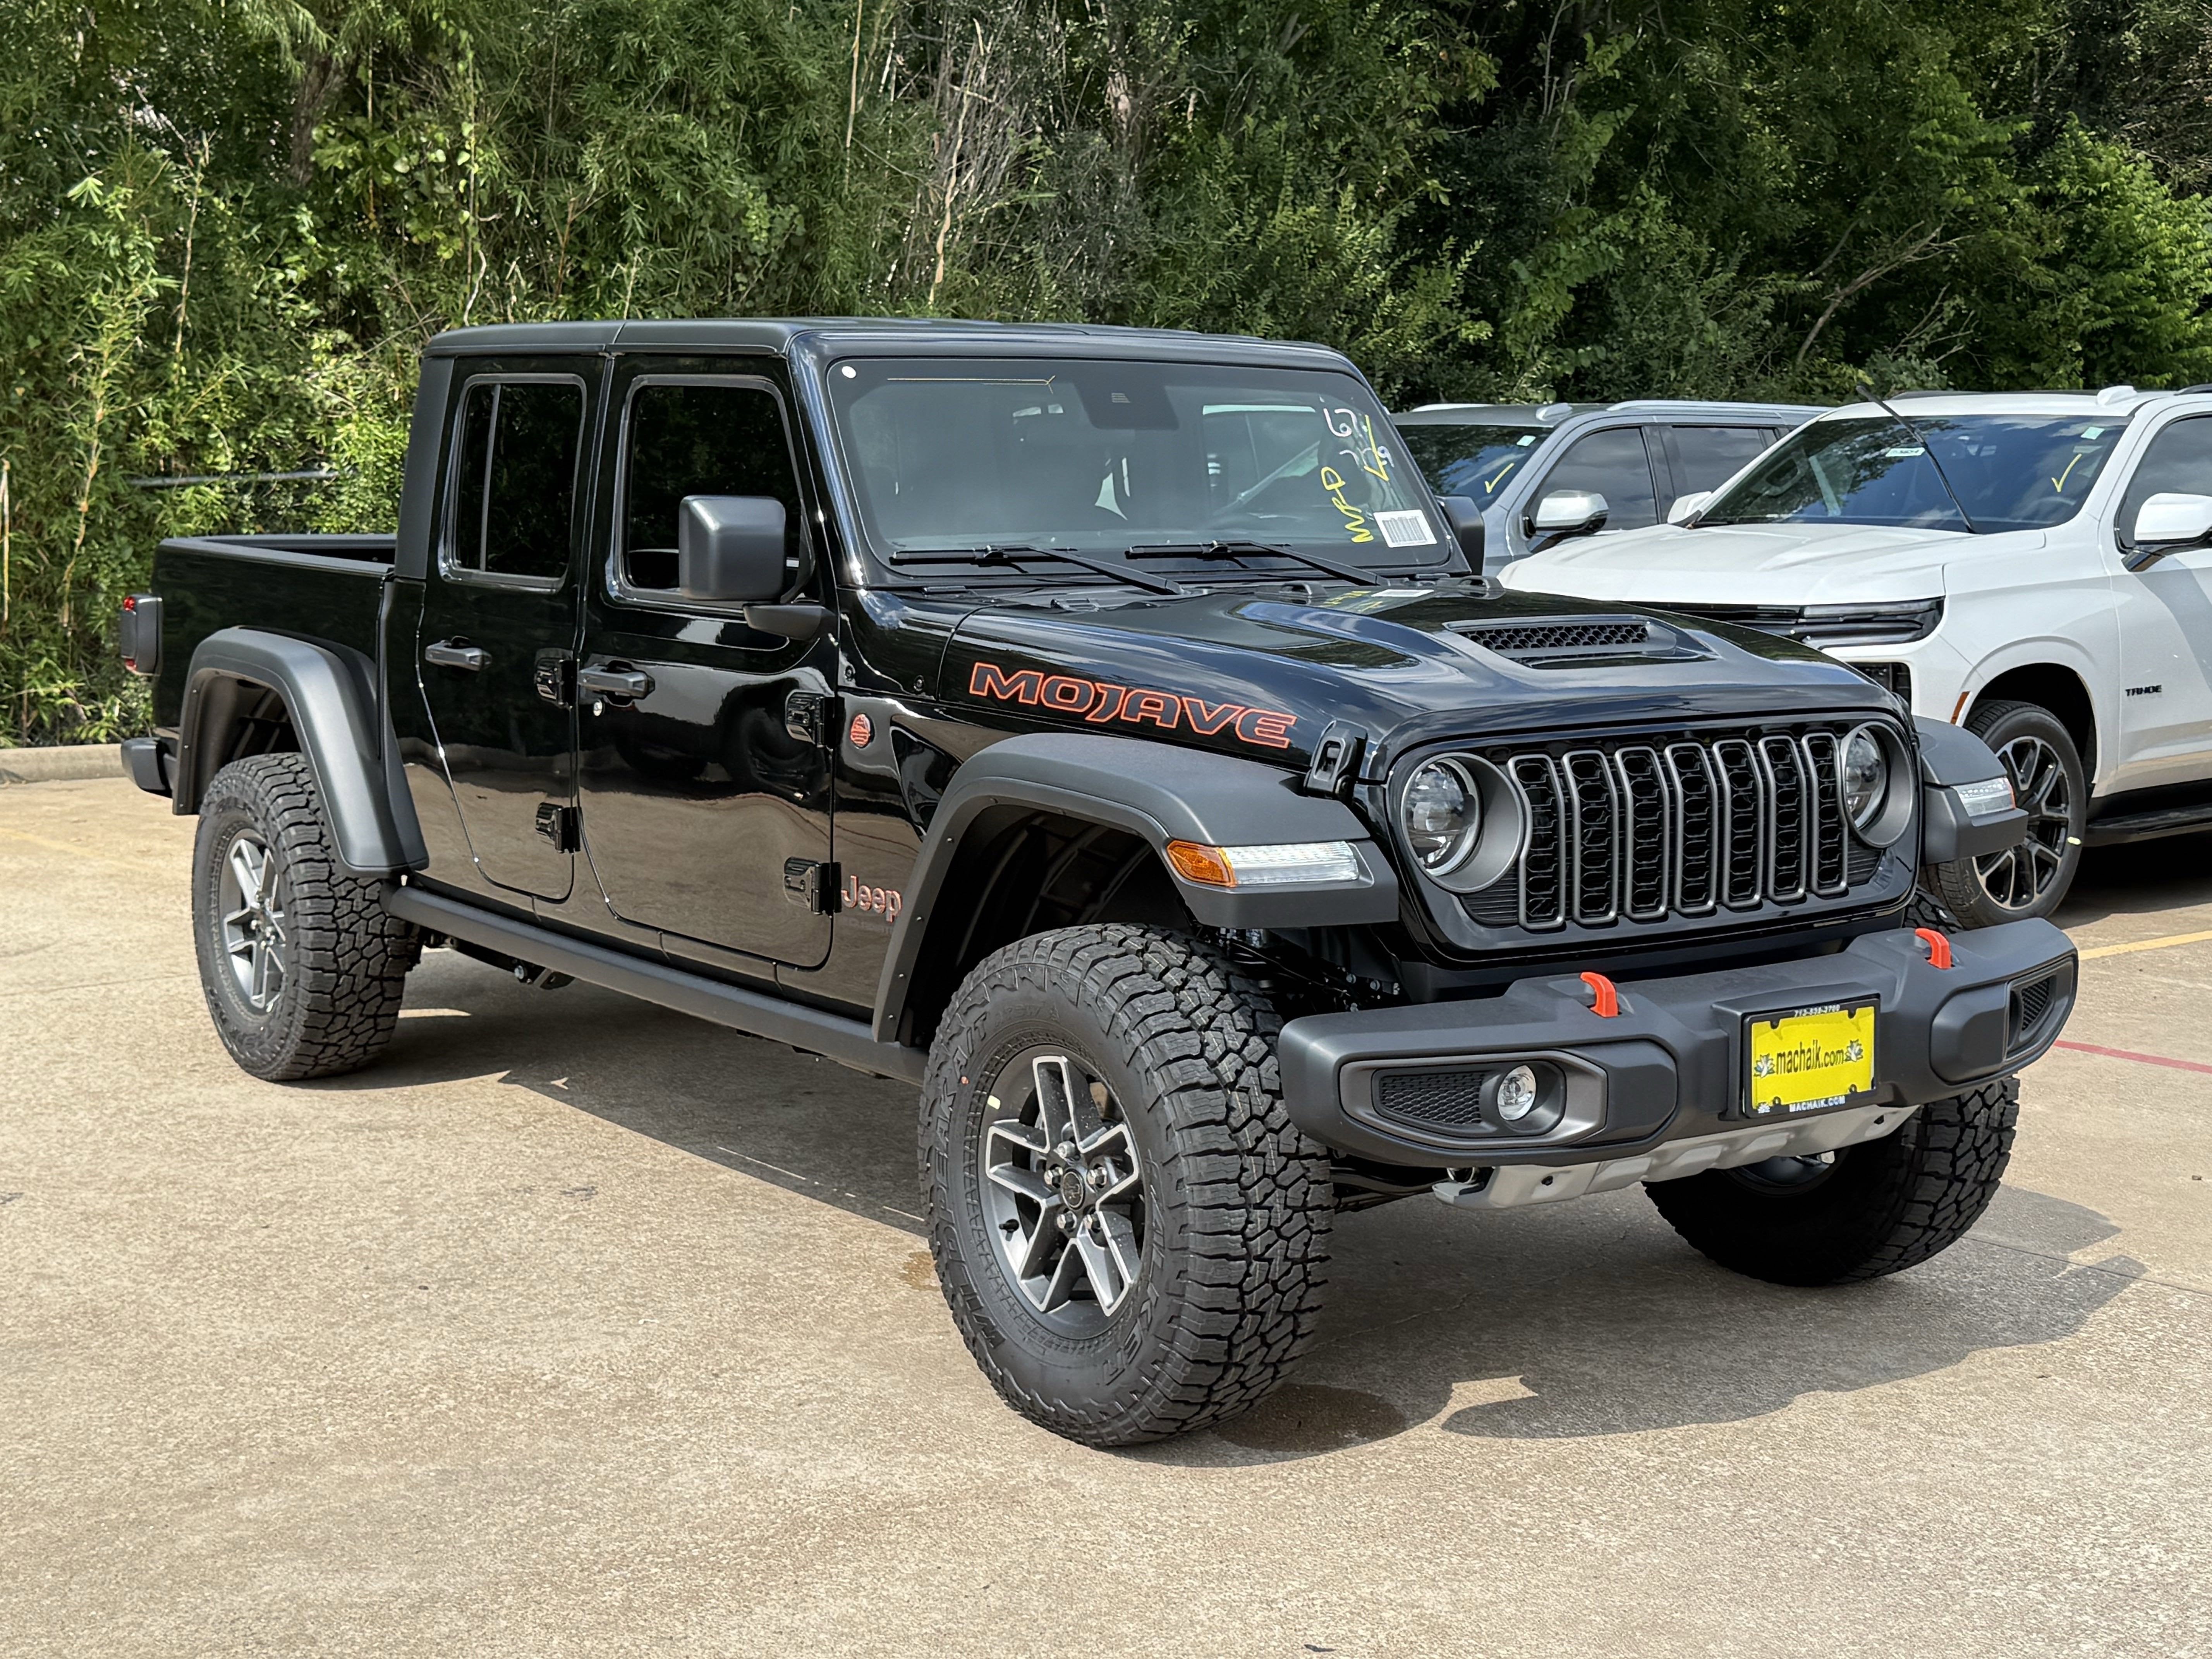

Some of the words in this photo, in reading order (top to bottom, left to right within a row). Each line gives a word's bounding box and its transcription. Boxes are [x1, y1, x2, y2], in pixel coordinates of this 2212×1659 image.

[969, 662, 1297, 749] MOJAVE
[2125, 684, 2162, 697] TAHOE
[841, 875, 902, 922] Jeep
[1776, 1039, 1844, 1075] machaik.com
[1789, 1095, 1846, 1113] MACHAIK.COM
